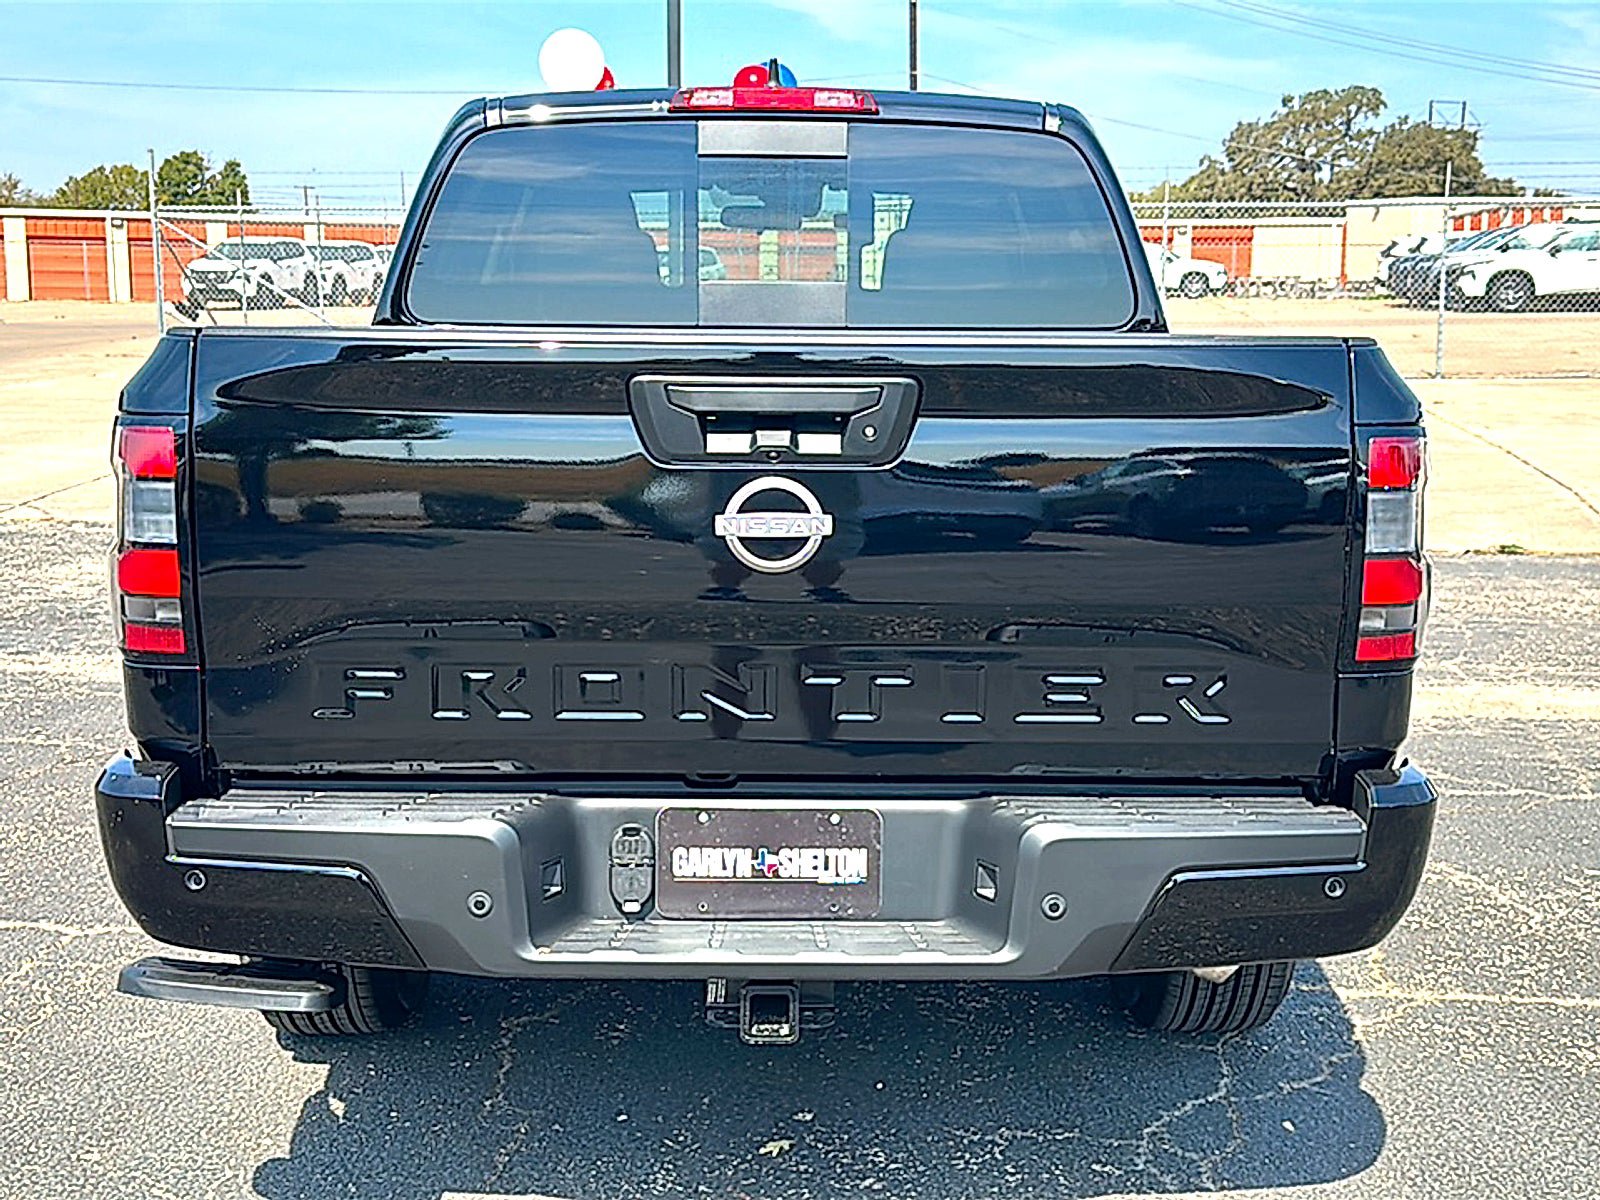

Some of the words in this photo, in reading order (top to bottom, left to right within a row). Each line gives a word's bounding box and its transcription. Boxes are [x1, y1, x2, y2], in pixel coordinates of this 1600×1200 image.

[718, 516, 831, 535] NISSAN
[311, 663, 1231, 724] FRONTIER
[672, 846, 753, 878] GARLYN
[778, 847, 868, 878] SHELTON
